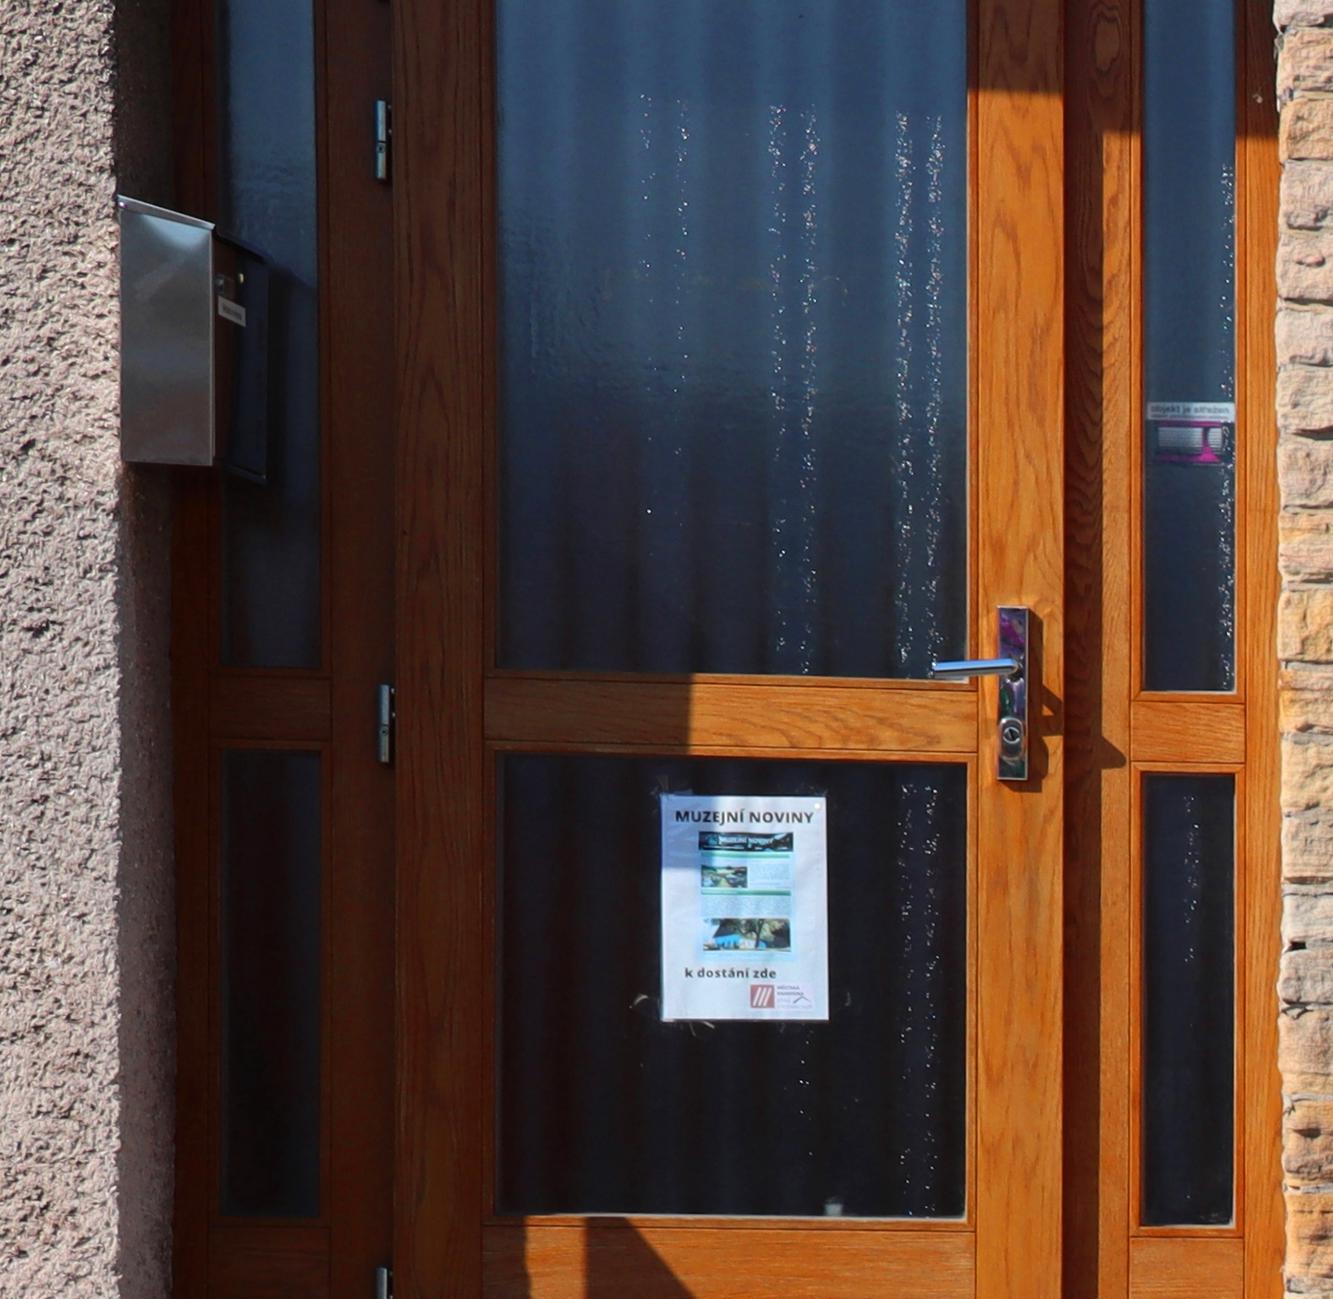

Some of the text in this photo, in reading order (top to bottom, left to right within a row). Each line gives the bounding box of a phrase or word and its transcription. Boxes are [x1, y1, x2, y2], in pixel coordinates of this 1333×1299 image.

[675, 808, 814, 825] MUZEJNÍ NOVINY
[685, 967, 777, 979] k dostání zde
